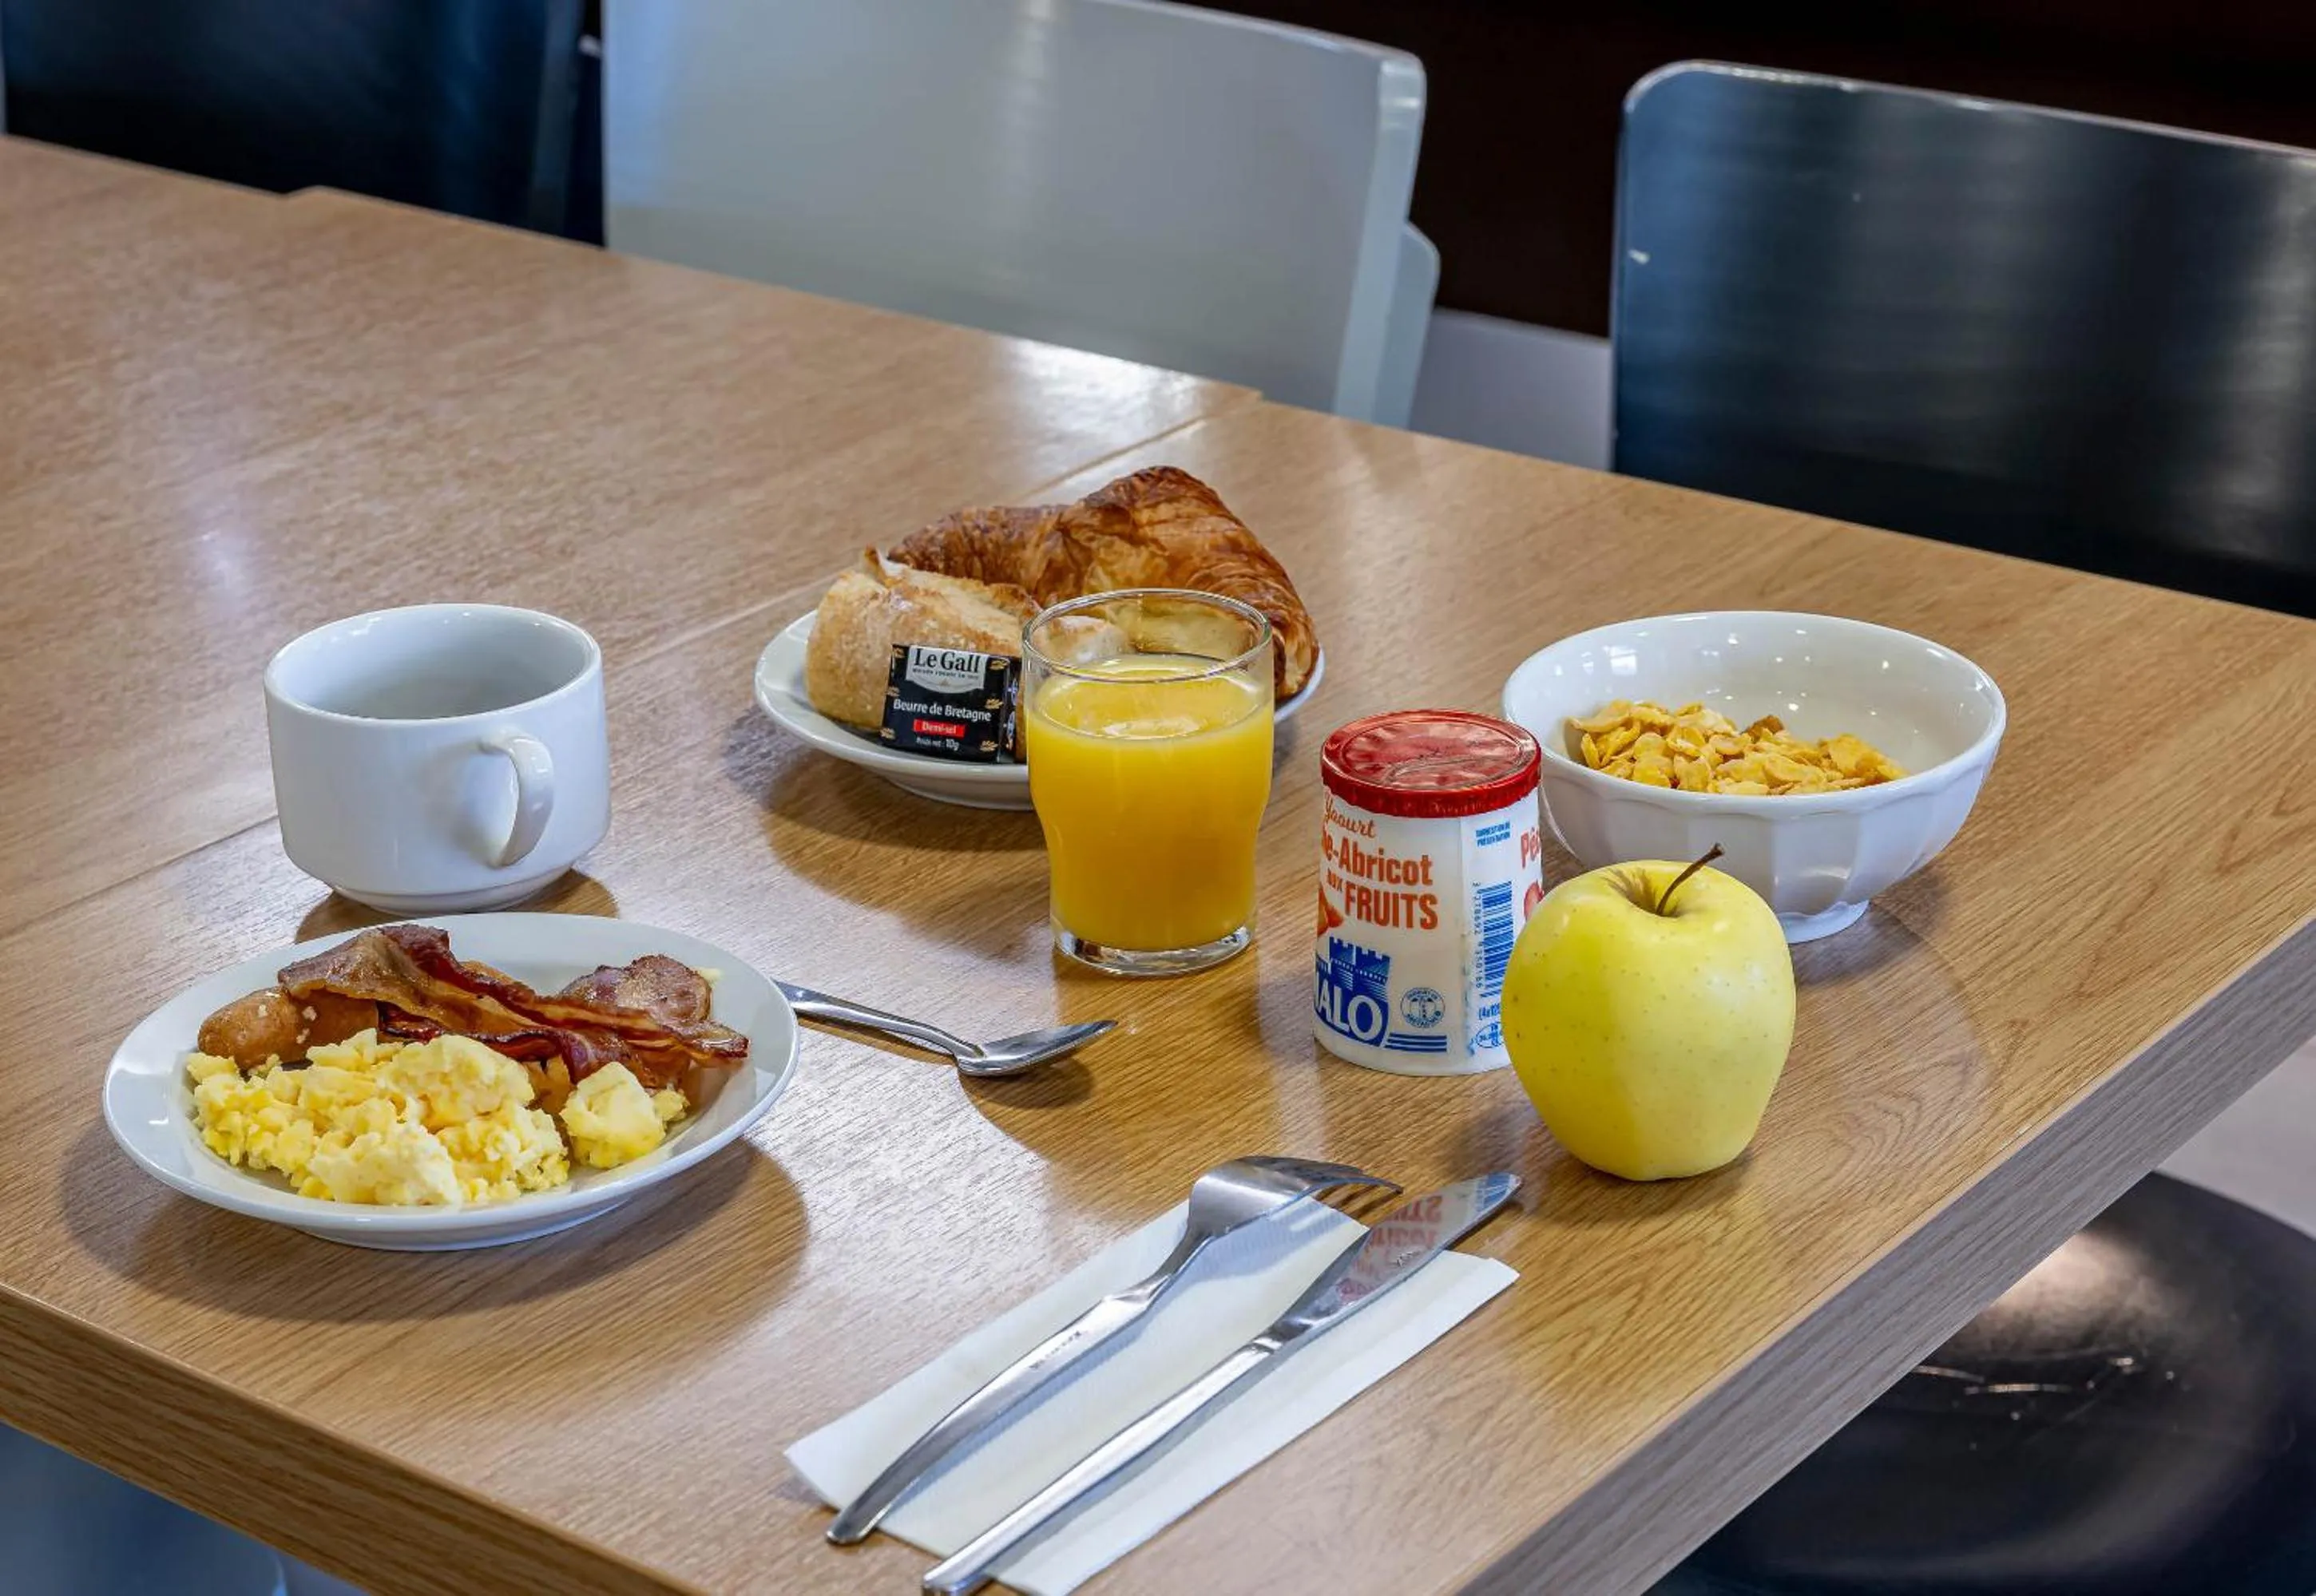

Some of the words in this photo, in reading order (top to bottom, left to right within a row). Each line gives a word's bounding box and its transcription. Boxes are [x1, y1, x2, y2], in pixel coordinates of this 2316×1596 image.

[914, 648, 937, 667] Le
[941, 651, 981, 673] Gall
[893, 699, 928, 714] Beurre
[930, 702, 942, 715] de
[945, 705, 991, 723] Bretagne
[1324, 794, 1376, 838] Yaourt
[1345, 880, 1439, 931] FRUITS
